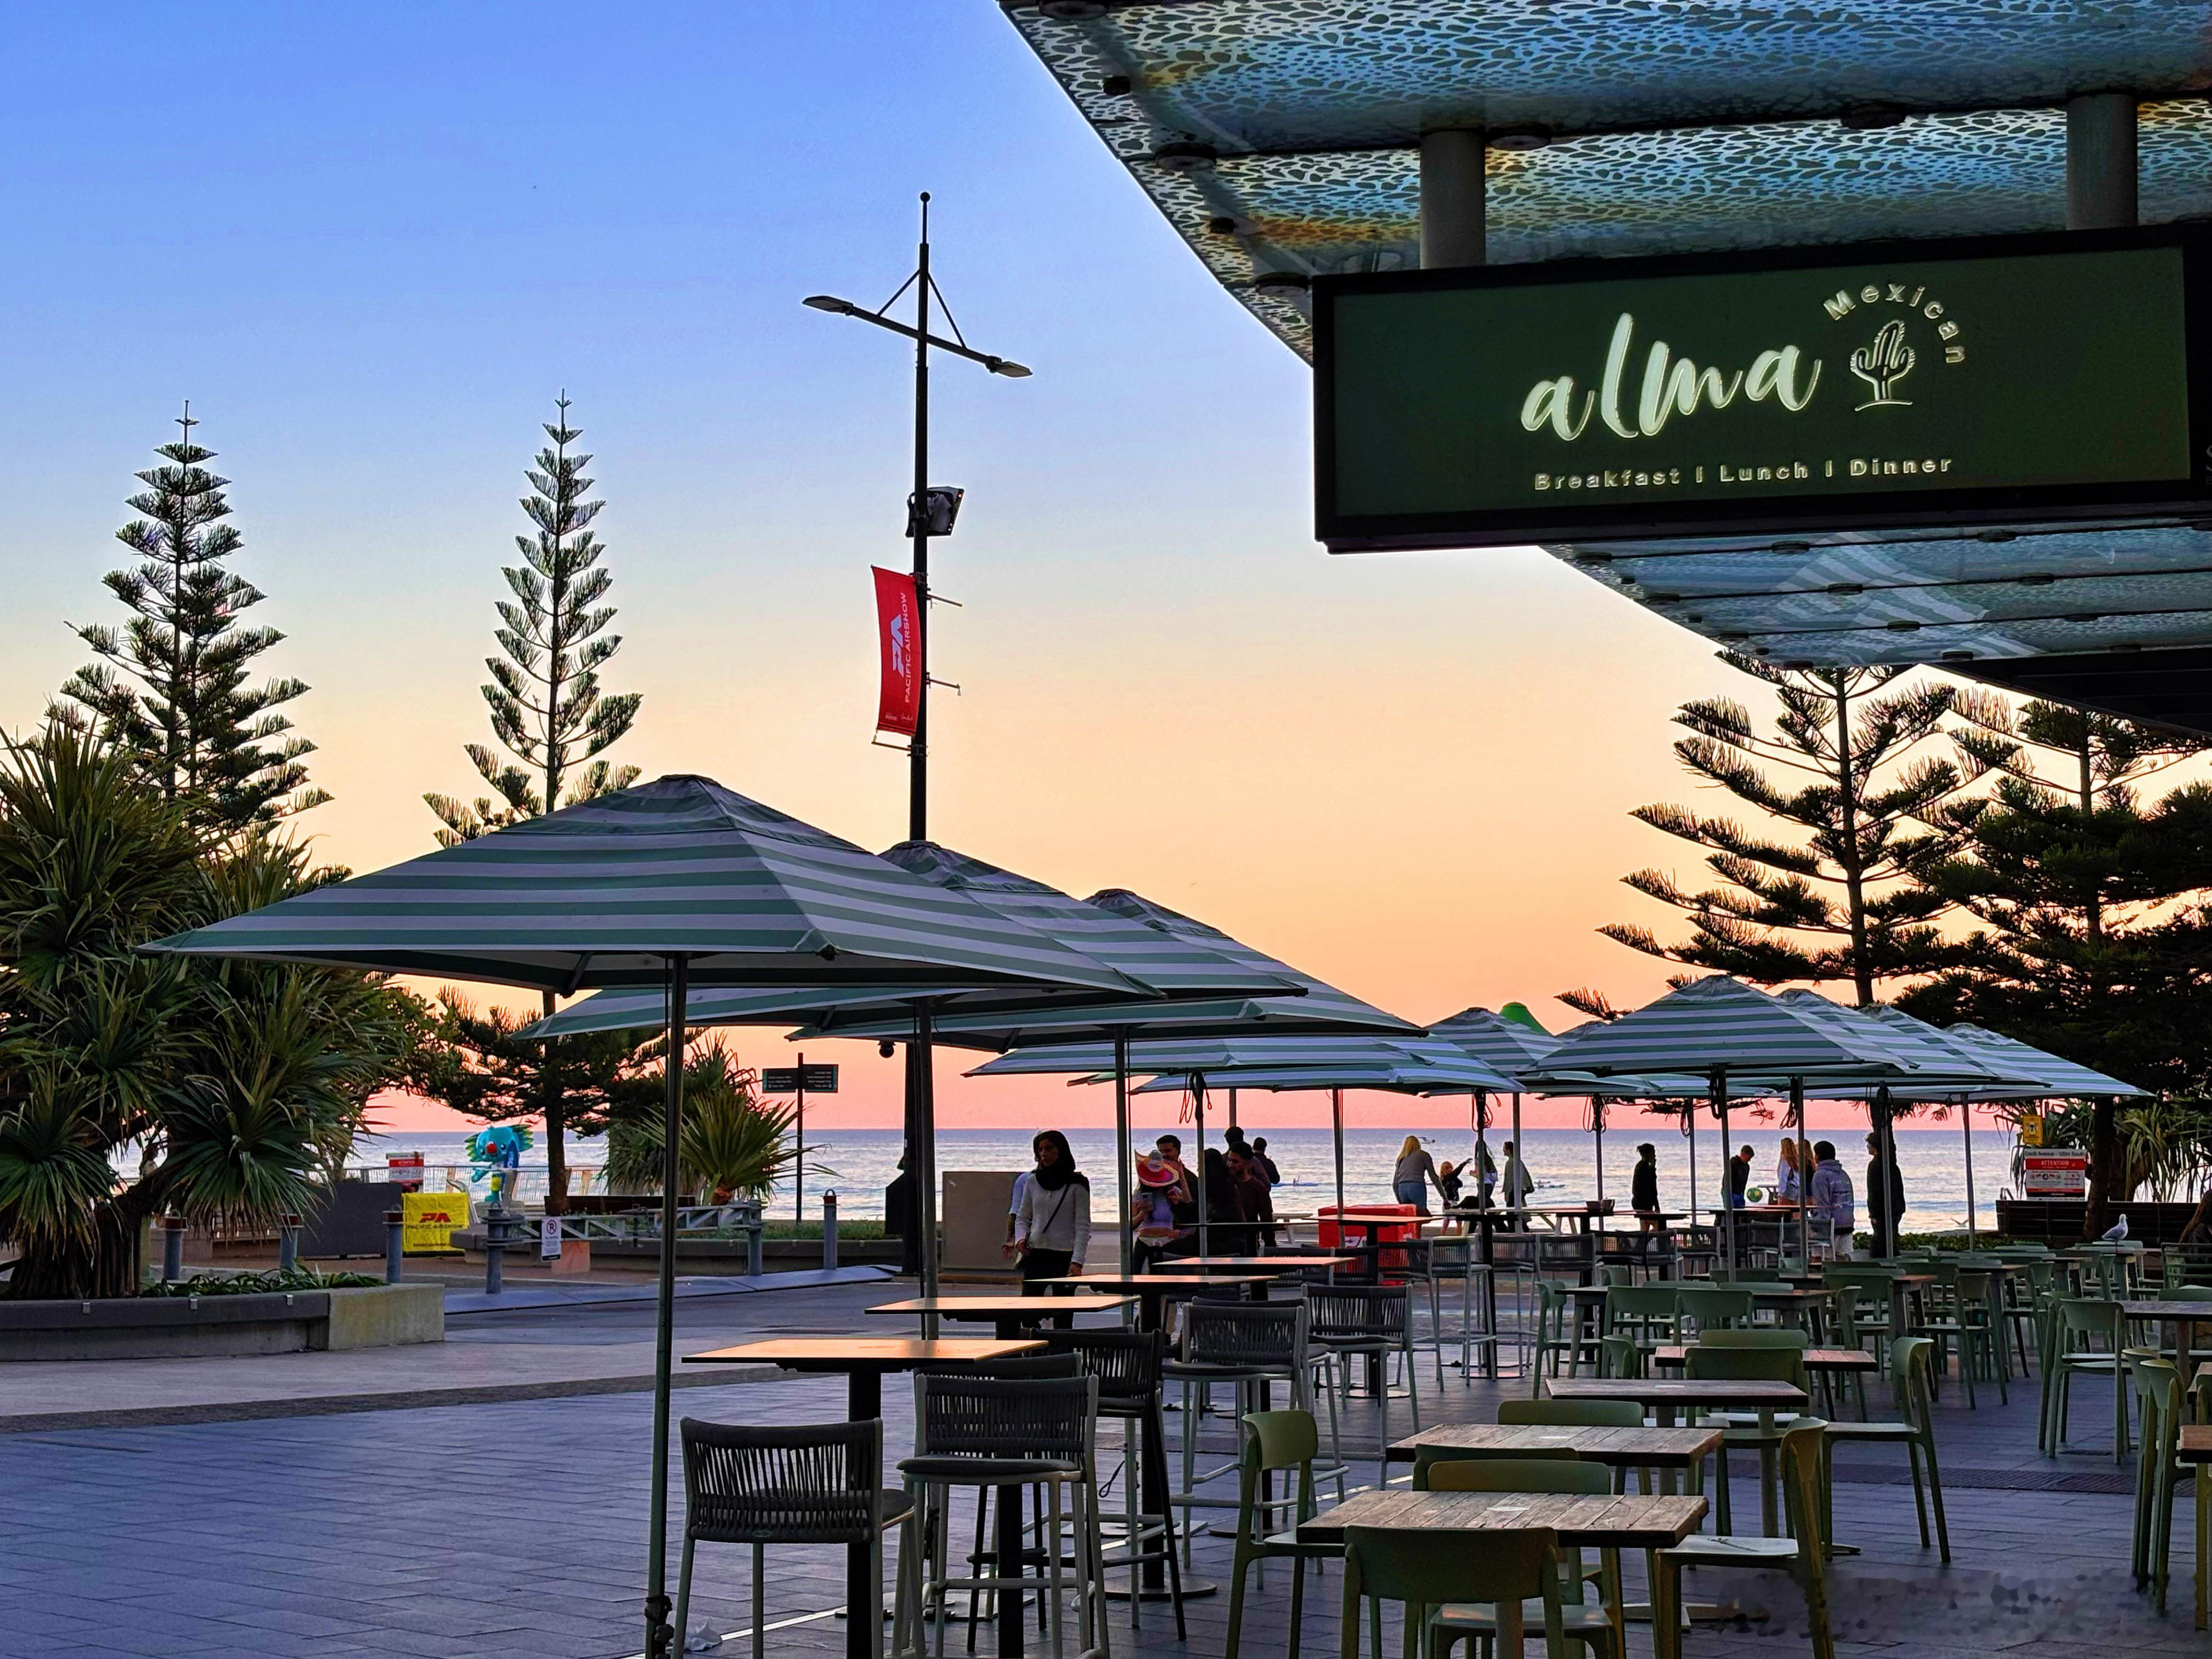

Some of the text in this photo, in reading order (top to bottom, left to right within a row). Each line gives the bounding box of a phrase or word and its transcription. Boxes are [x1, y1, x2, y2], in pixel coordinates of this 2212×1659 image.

[1823, 284, 1966, 363] Mexican
[1521, 312, 1822, 441] alma
[1534, 467, 1680, 490] Breakfast
[1719, 461, 1809, 482] Lunch
[1850, 458, 1952, 477] Dinner
[901, 592, 911, 651] AIRSHOW
